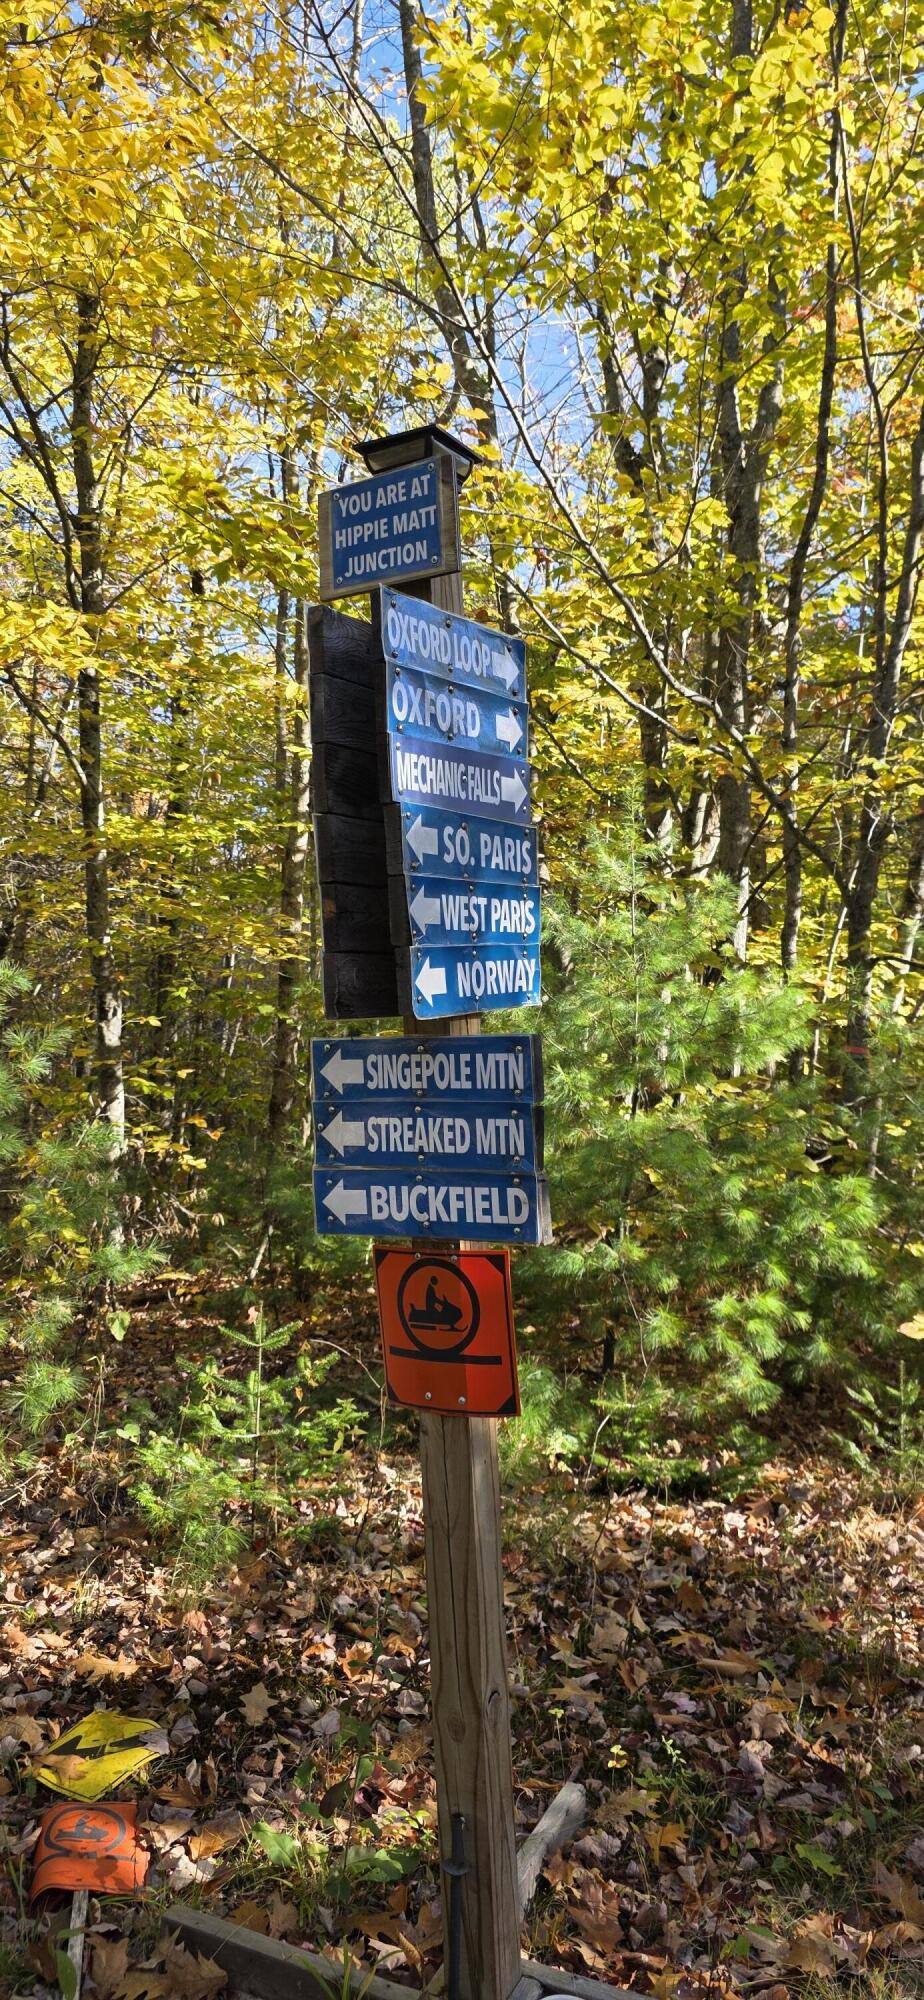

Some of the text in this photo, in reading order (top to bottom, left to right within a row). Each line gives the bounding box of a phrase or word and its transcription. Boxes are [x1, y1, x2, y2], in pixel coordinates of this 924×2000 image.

[338, 474, 431, 518] YOU ARE AT
[335, 505, 437, 549] HIPPIE MATT
[344, 540, 428, 578] JUNCTION
[387, 607, 491, 678] OXFORD LOOP
[392, 681, 480, 738] OXFORD
[396, 750, 501, 806] MECHANIC FALLS
[443, 826, 532, 874] SO. PARIS
[441, 894, 535, 934] WEST PARIS
[456, 959, 536, 998] NORWAY
[366, 1053, 524, 1090] SINGEPOLE MTN
[367, 1116, 525, 1156] STREAKED MTN
[369, 1185, 529, 1225] BUCKFIELD
